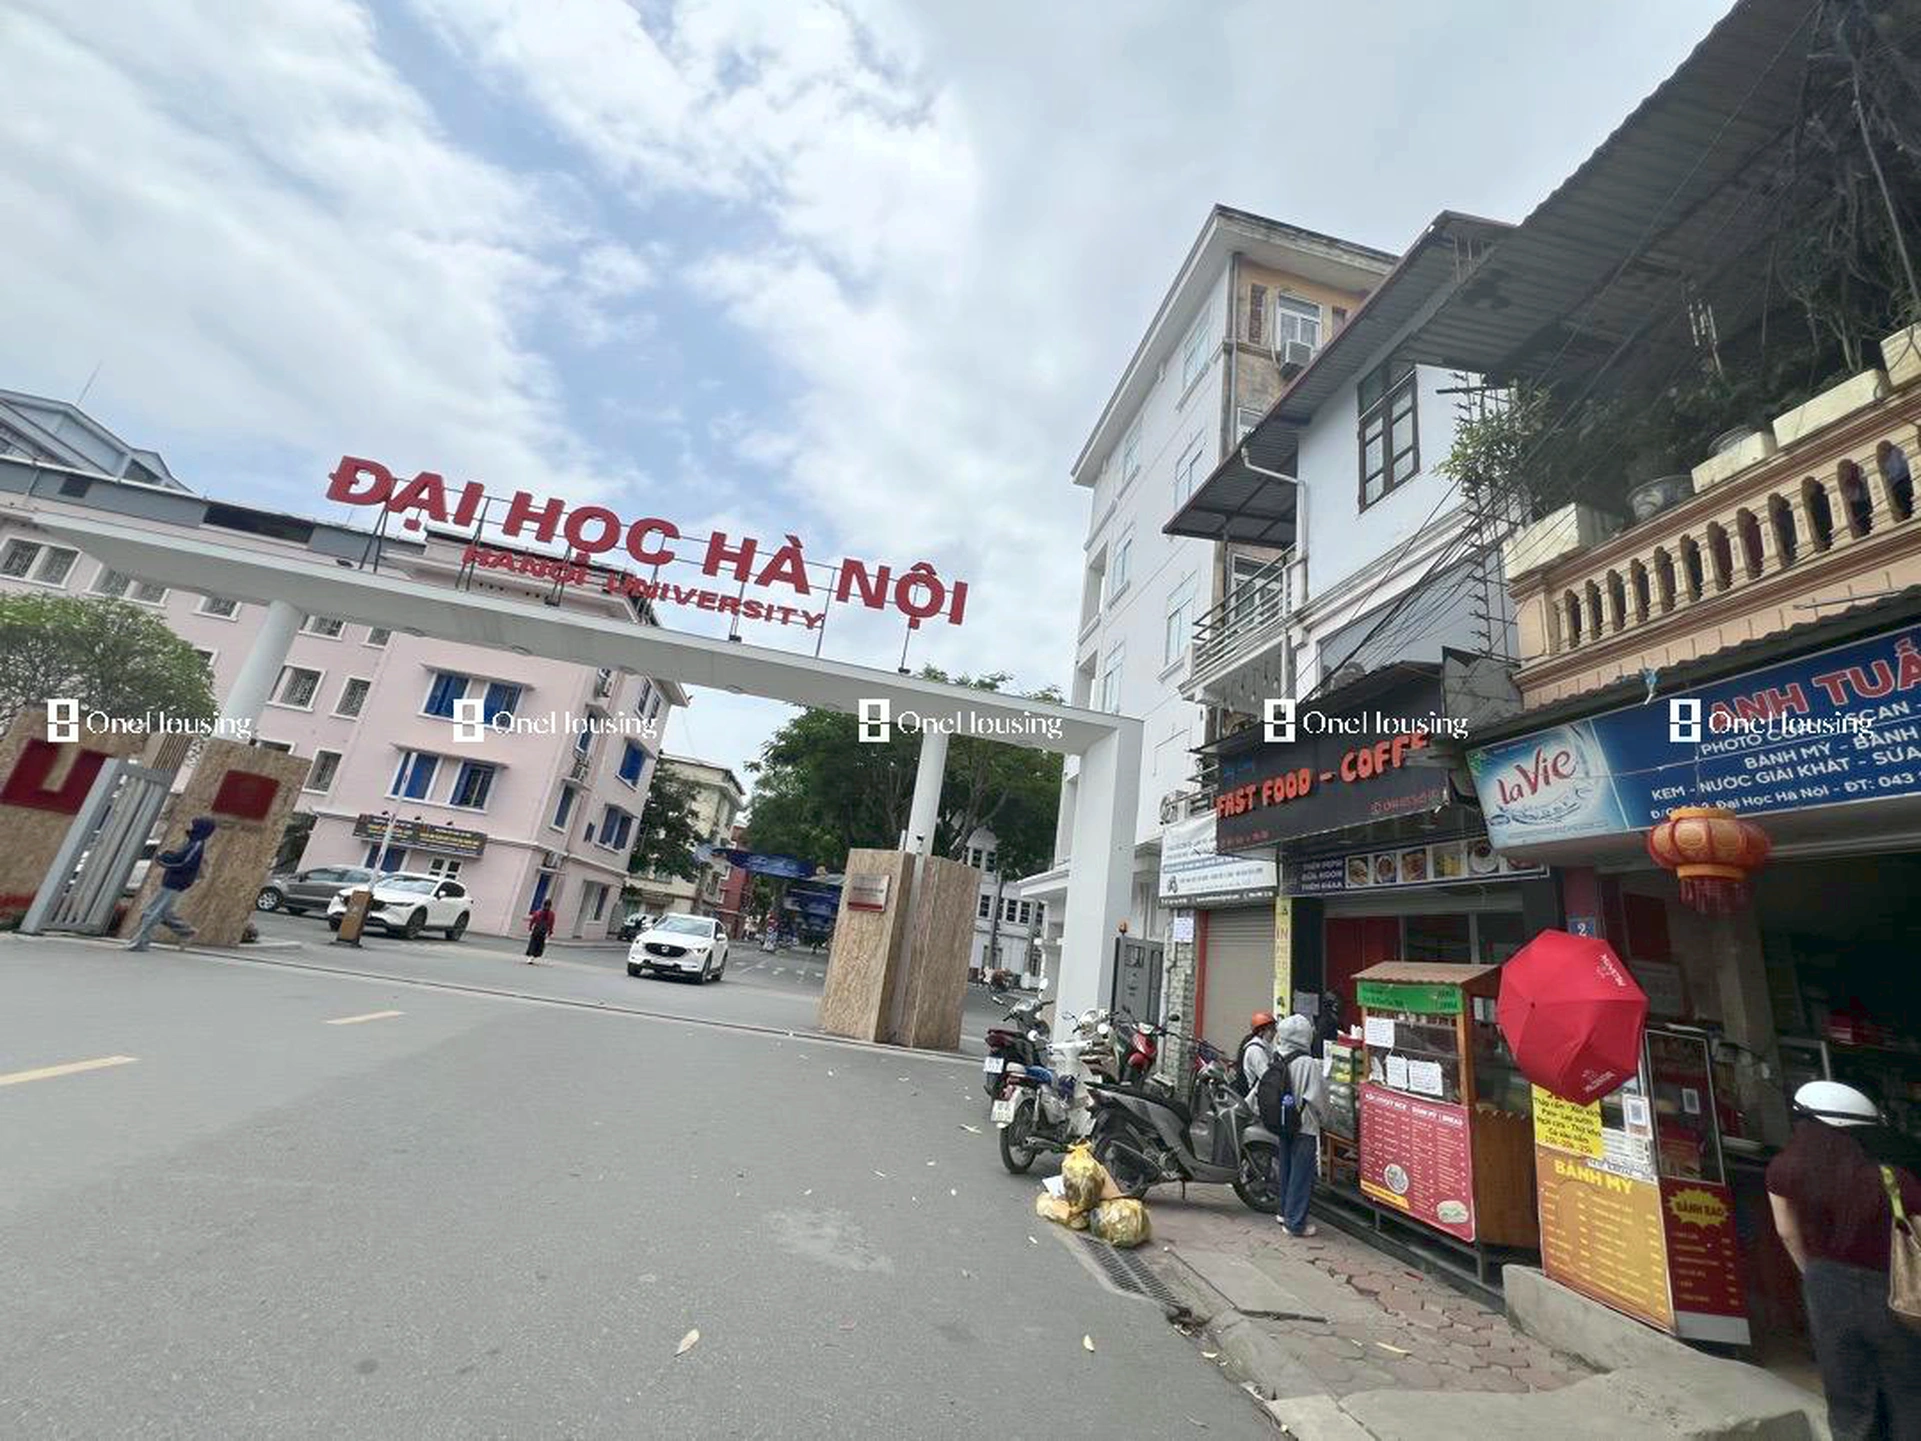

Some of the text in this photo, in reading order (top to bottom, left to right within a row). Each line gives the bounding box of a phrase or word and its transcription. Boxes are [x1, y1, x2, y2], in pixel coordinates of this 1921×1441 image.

[326, 455, 969, 630] ĐẠI HỌC HÀ NỘI
[461, 546, 828, 630] HANOI UNIVERSITY
[1711, 682, 1810, 735] ANH
[1701, 733, 1763, 756] PHOTO
[1216, 783, 1257, 818] FAST
[1262, 767, 1312, 806] FOOD
[1651, 785, 1686, 802] KEM
[1844, 778, 1876, 793] ĐT:
[1878, 772, 1915, 788] 043
